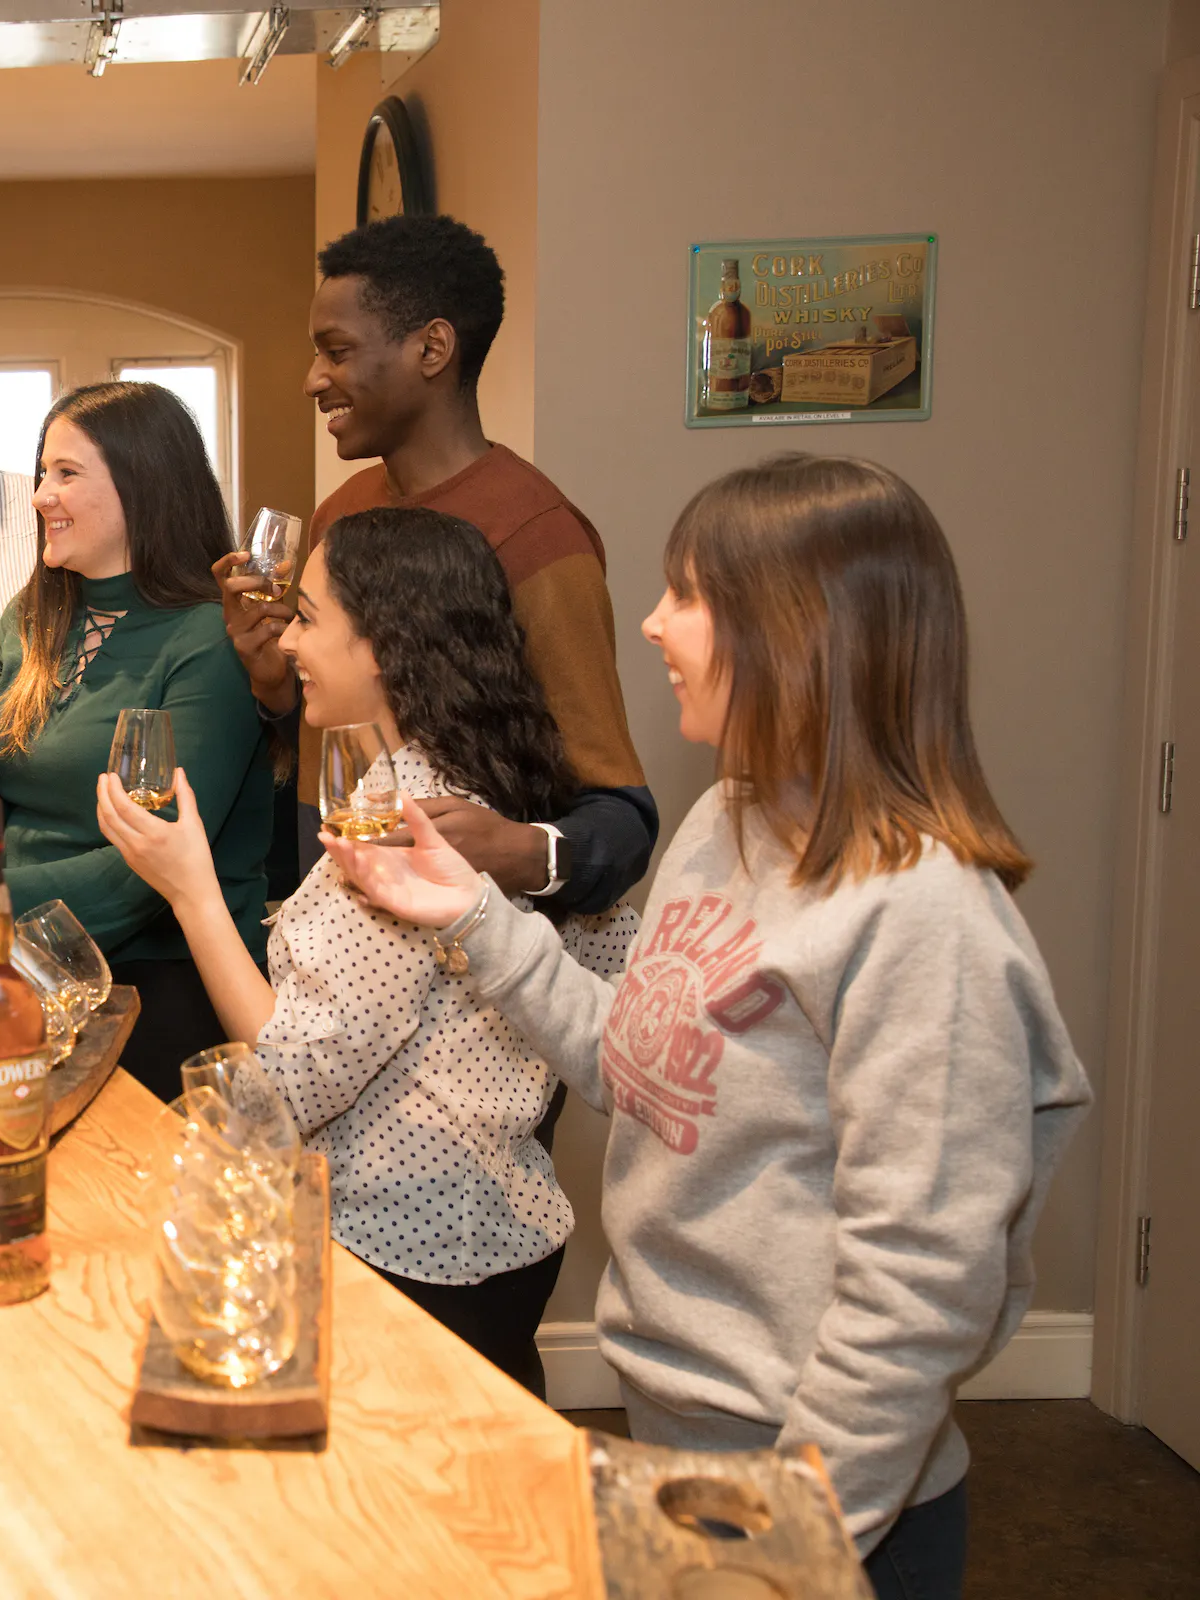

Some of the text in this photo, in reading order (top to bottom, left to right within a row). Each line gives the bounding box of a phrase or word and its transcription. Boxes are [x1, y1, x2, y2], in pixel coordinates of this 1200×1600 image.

[755, 259, 891, 307] DISTILLERIES
[774, 307, 873, 325] WHISKY
[804, 359, 856, 368] DISTILLERIES
